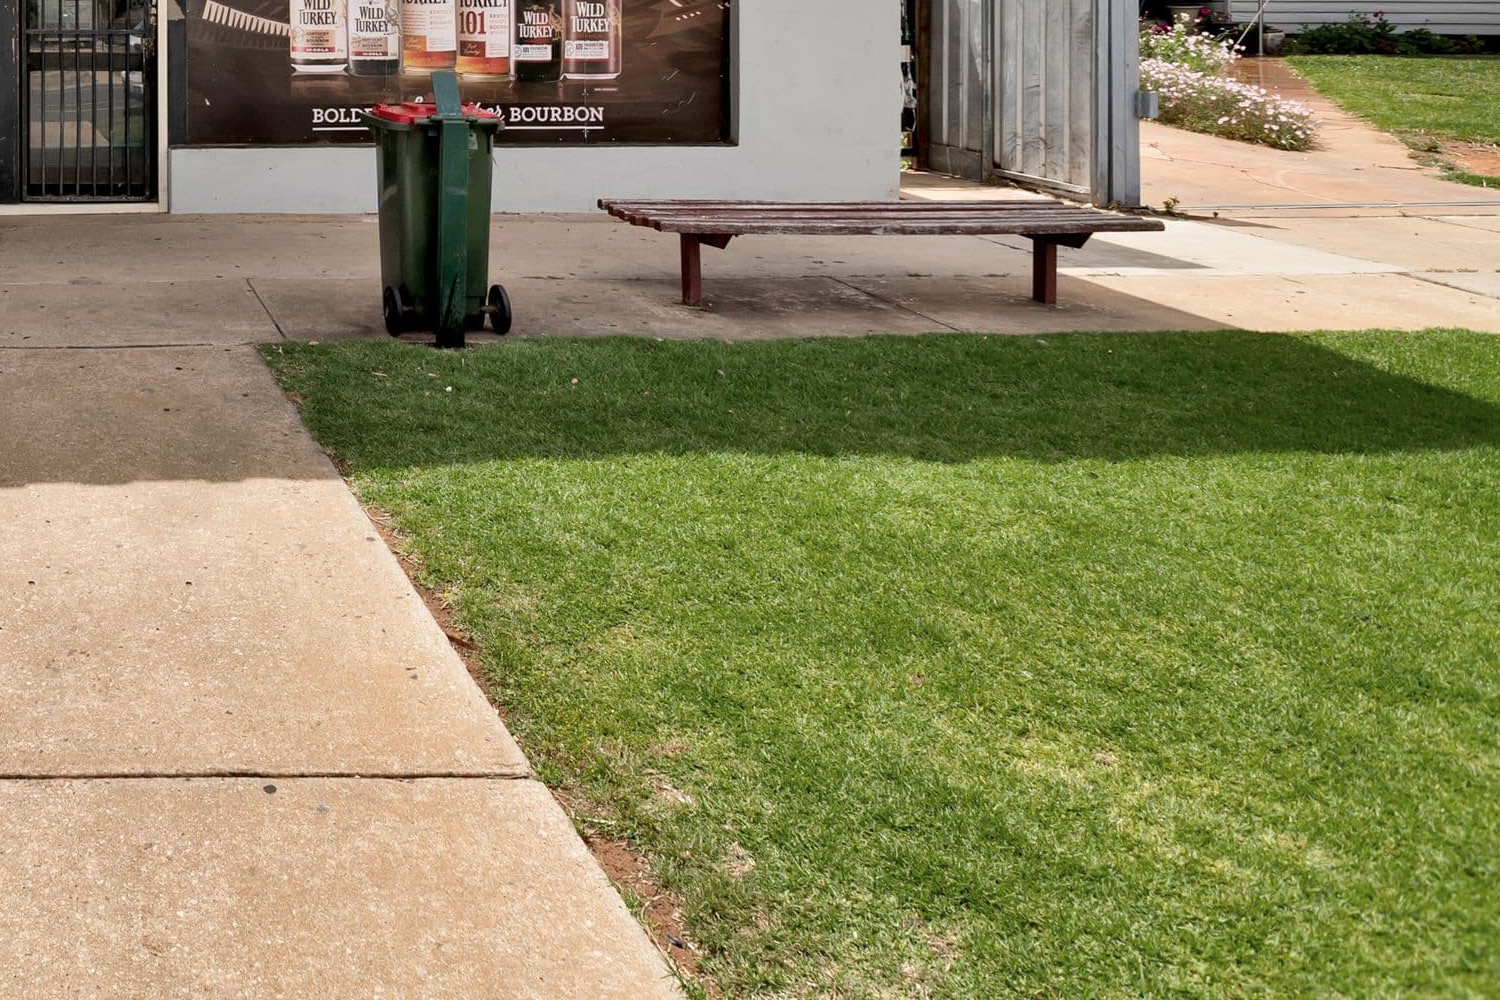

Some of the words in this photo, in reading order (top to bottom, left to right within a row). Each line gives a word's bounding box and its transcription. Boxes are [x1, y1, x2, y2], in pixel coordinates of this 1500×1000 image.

[359, 6, 384, 19] WILD
[576, 2, 604, 17] WILD
[299, 9, 337, 25] TURKEY
[459, 11, 486, 34] 101
[523, 11, 548, 25] WILD
[355, 18, 389, 32] TURKEY
[518, 24, 554, 38] TURKEY
[571, 16, 610, 33] TURKEY
[312, 109, 372, 123] BOLD
[509, 107, 604, 122] BOURBON
